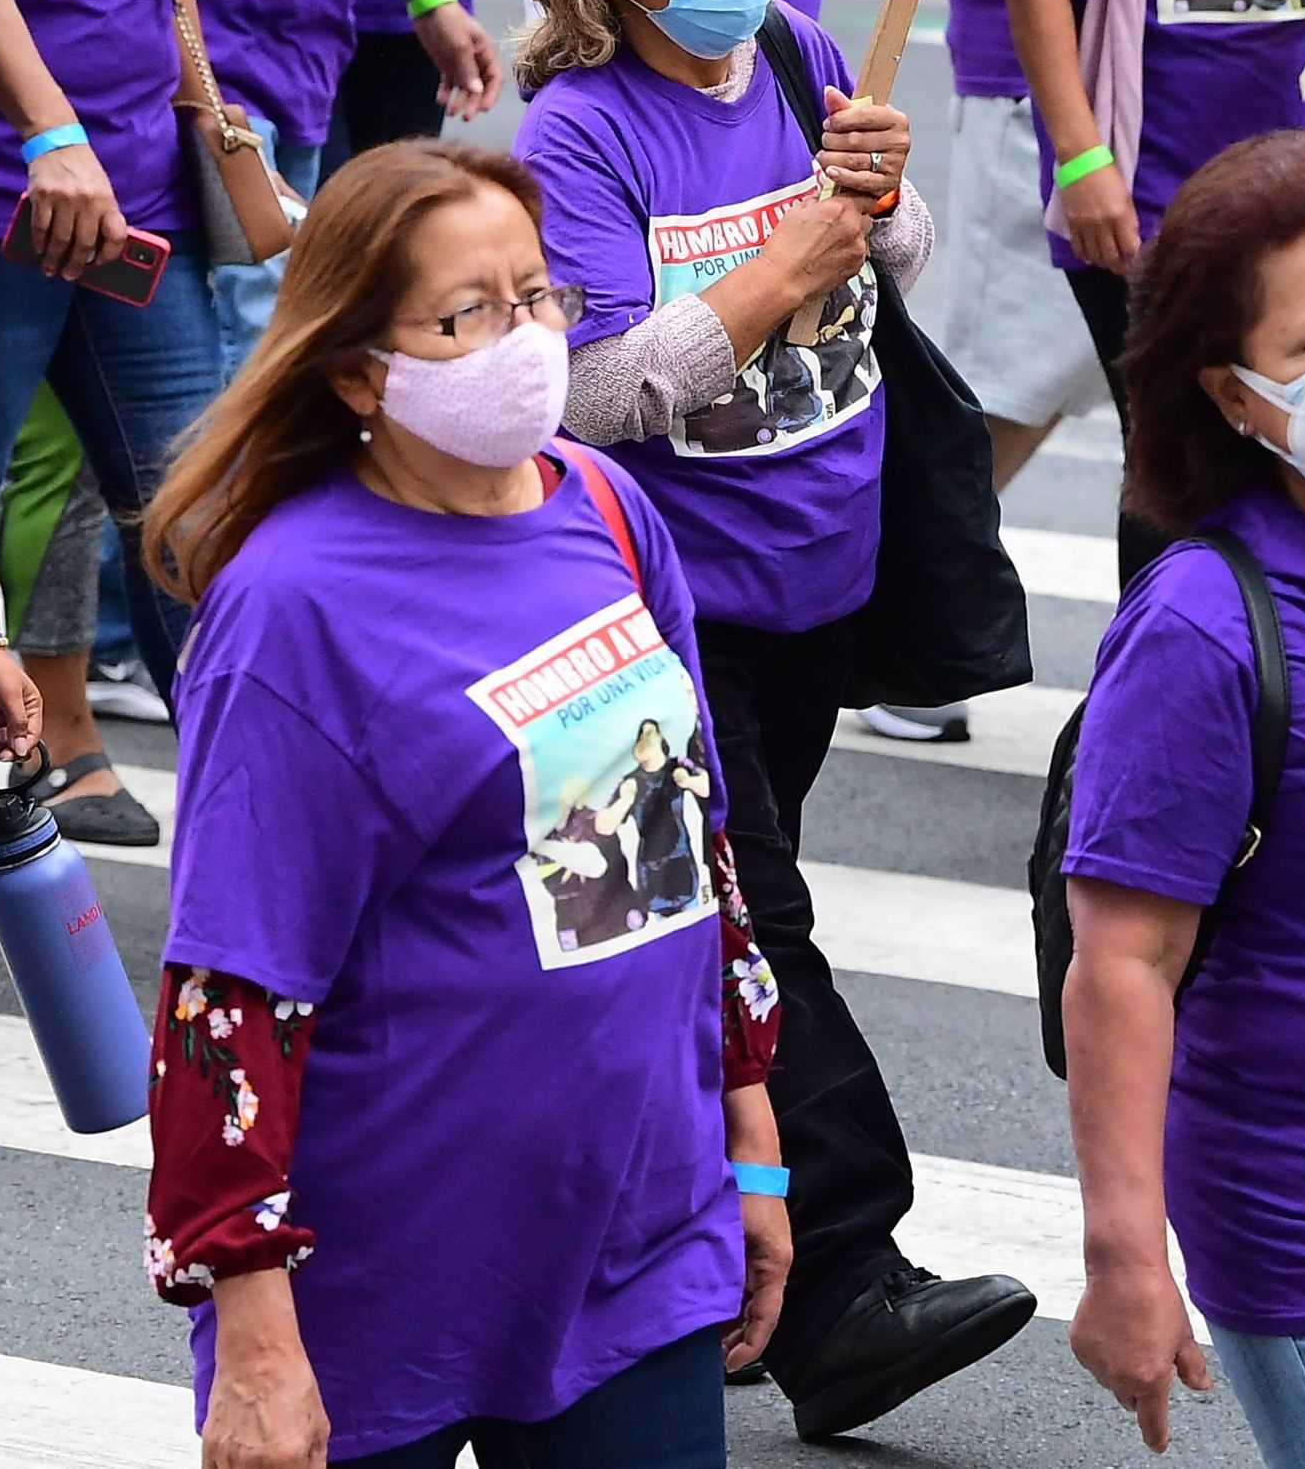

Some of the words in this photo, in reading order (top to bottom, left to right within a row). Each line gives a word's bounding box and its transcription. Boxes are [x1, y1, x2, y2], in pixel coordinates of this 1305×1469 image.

[693, 257, 729, 279] POR
[494, 636, 616, 723] HOMBRO
[606, 625, 637, 661] A
[556, 695, 595, 729] POR
[598, 674, 635, 706] UNA
[629, 654, 666, 683] VIDA
